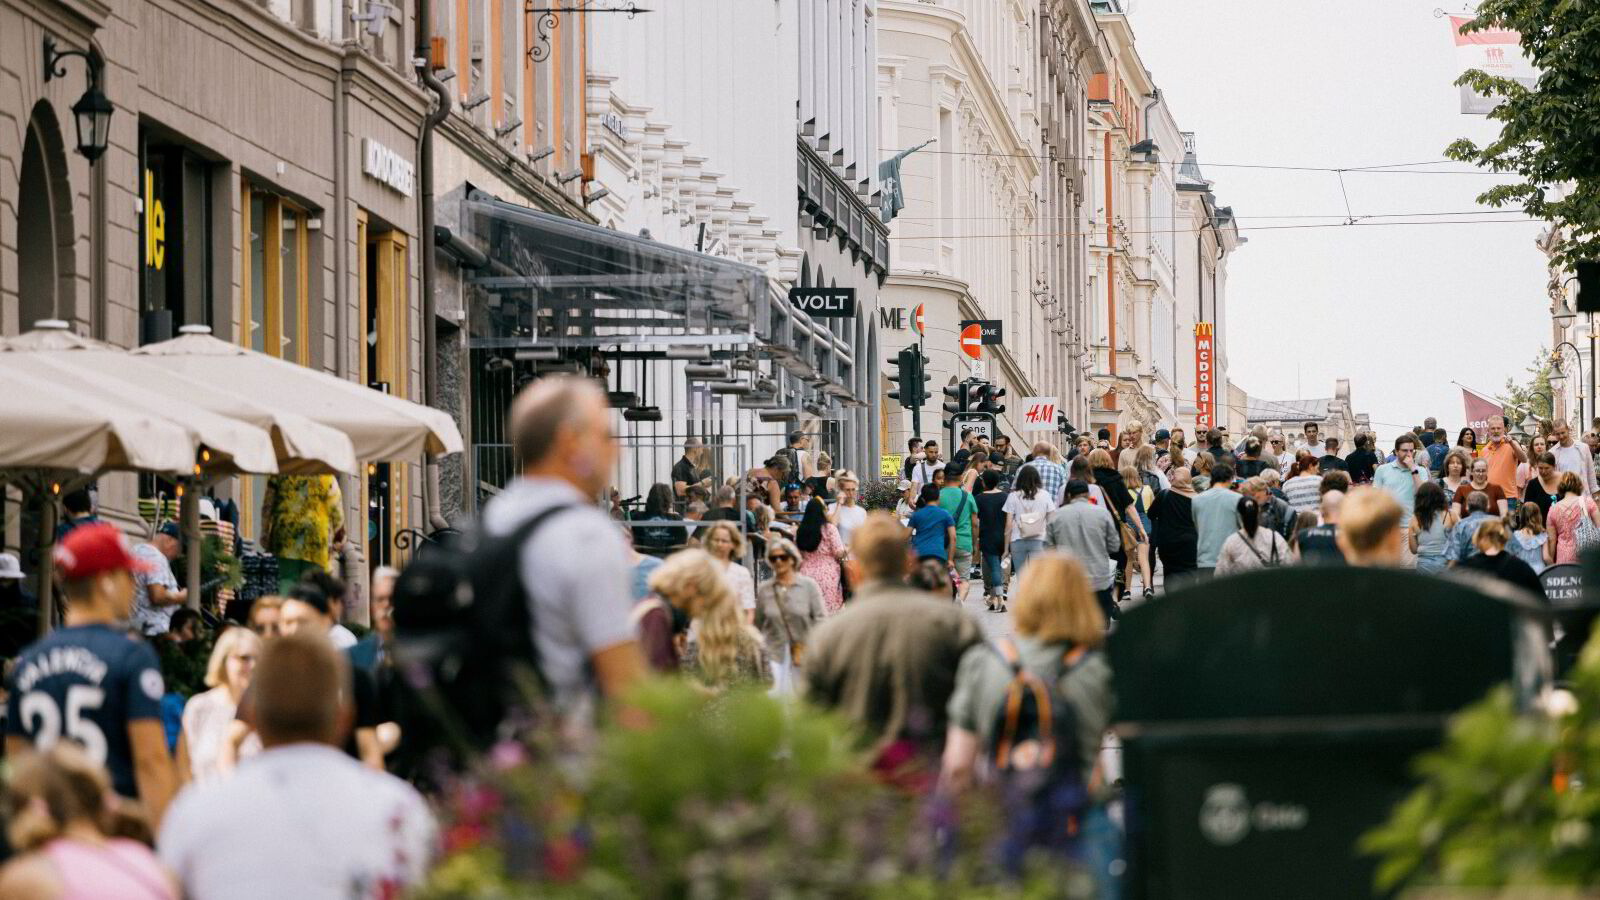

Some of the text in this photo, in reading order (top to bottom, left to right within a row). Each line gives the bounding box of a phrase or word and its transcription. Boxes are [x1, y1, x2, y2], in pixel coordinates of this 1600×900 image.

[796, 295, 849, 310] VOLT
[980, 328, 998, 336] OME
[1198, 340, 1211, 424] McDonald'
[1025, 404, 1054, 423] H&M
[20, 684, 108, 770] 25
